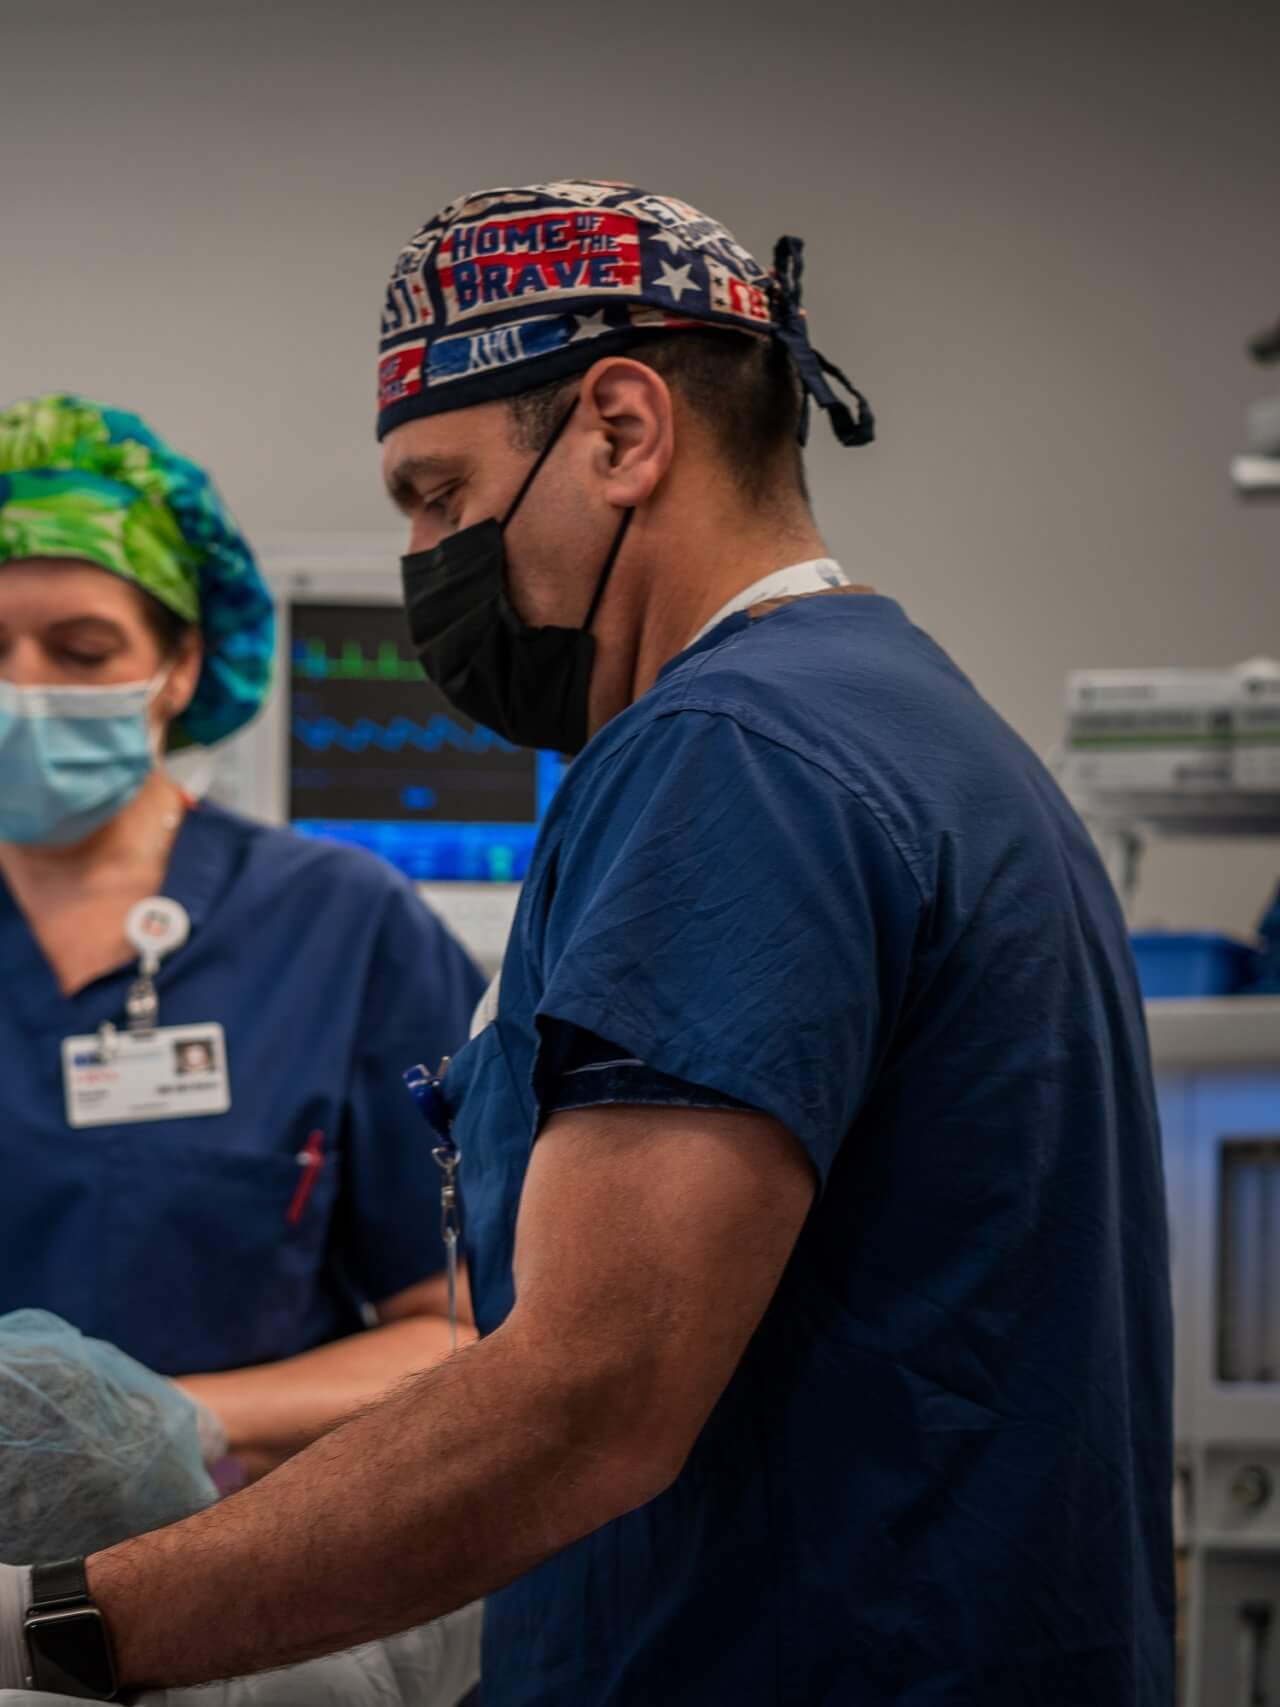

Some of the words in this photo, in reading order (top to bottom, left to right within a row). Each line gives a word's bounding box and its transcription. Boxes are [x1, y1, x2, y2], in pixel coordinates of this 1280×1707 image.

[576, 214, 605, 232] OF
[452, 218, 570, 263] HOME
[577, 233, 622, 255] THE
[452, 256, 623, 311] BRAVE
